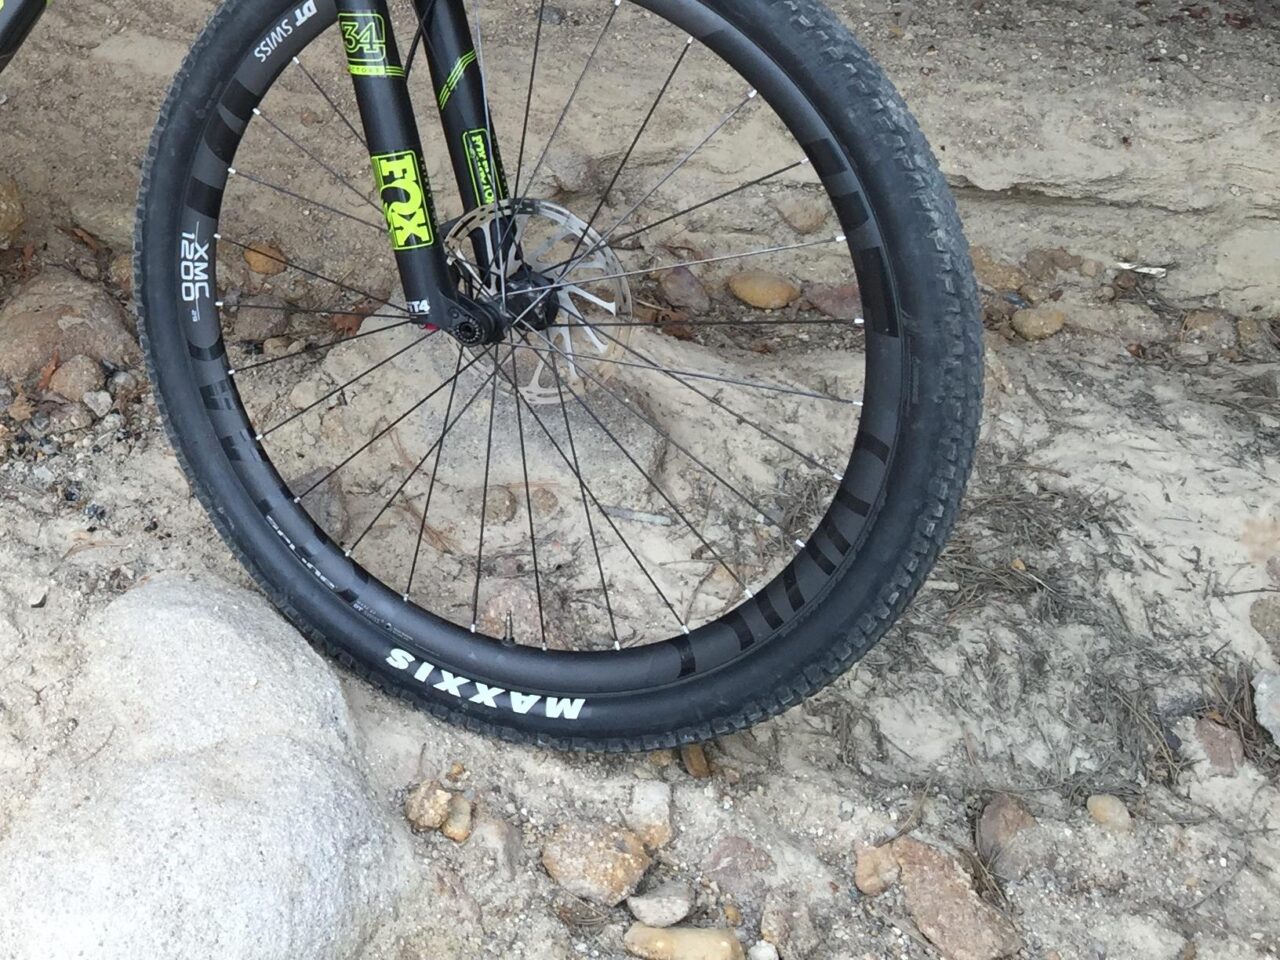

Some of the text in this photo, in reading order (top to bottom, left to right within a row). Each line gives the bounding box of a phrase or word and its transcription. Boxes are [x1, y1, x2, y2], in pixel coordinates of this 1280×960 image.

[254, 18, 293, 63] SWISS
[342, 21, 384, 54] 34
[380, 155, 429, 245] FOX
[180, 232, 195, 302] 1200
[194, 241, 210, 298] XMC
[385, 648, 586, 720] MAXXIS
